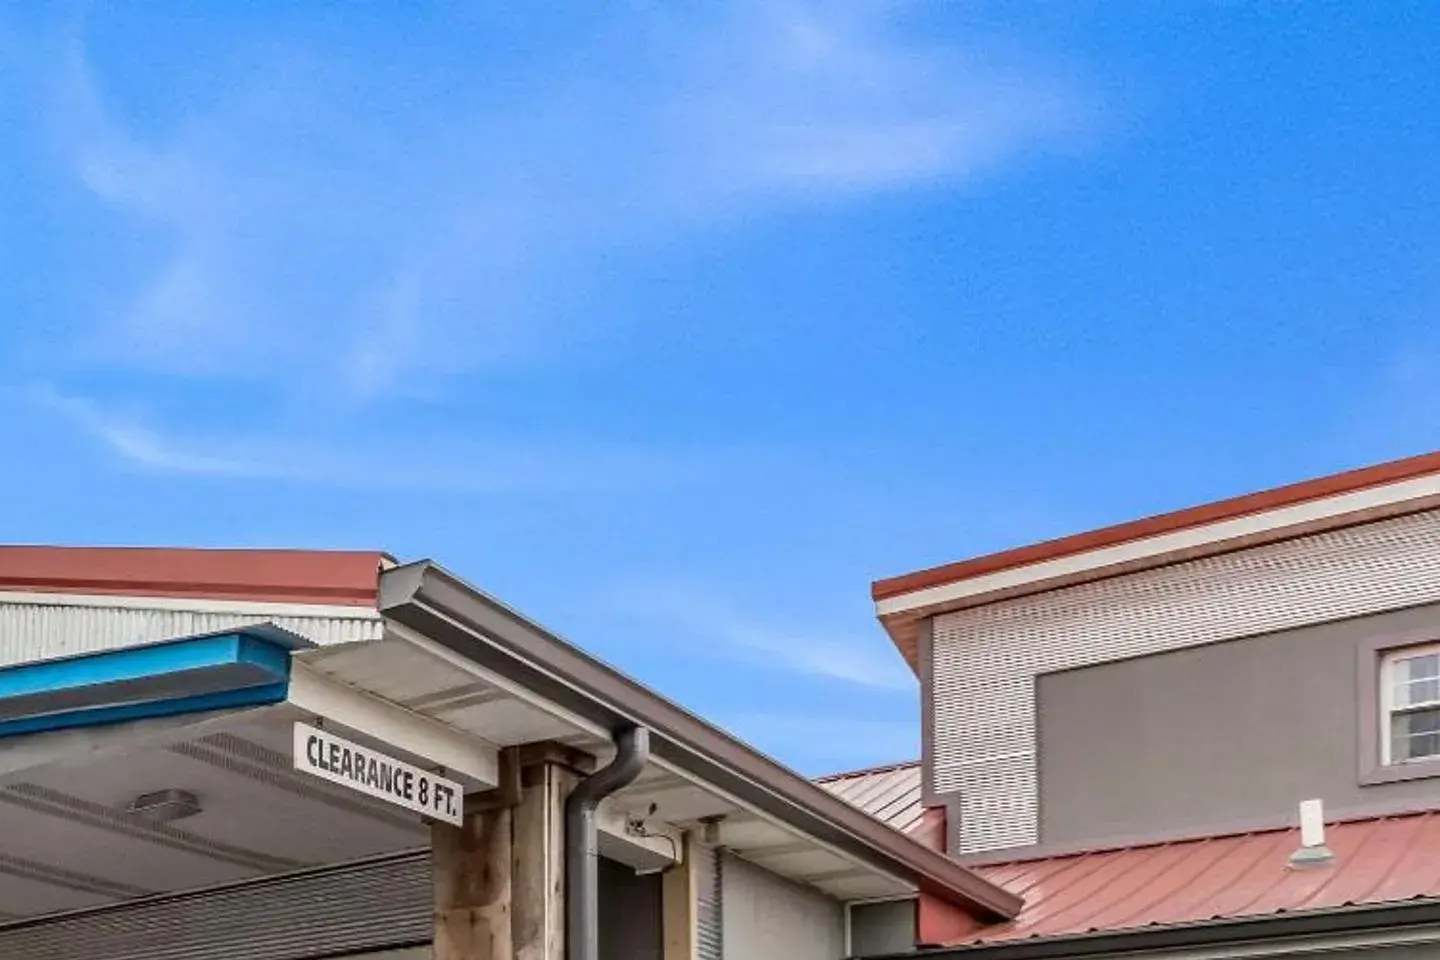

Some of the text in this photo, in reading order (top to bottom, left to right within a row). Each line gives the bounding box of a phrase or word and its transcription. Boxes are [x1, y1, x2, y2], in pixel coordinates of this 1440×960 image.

[306, 735, 457, 817] CLEARANCE 8 FT.
